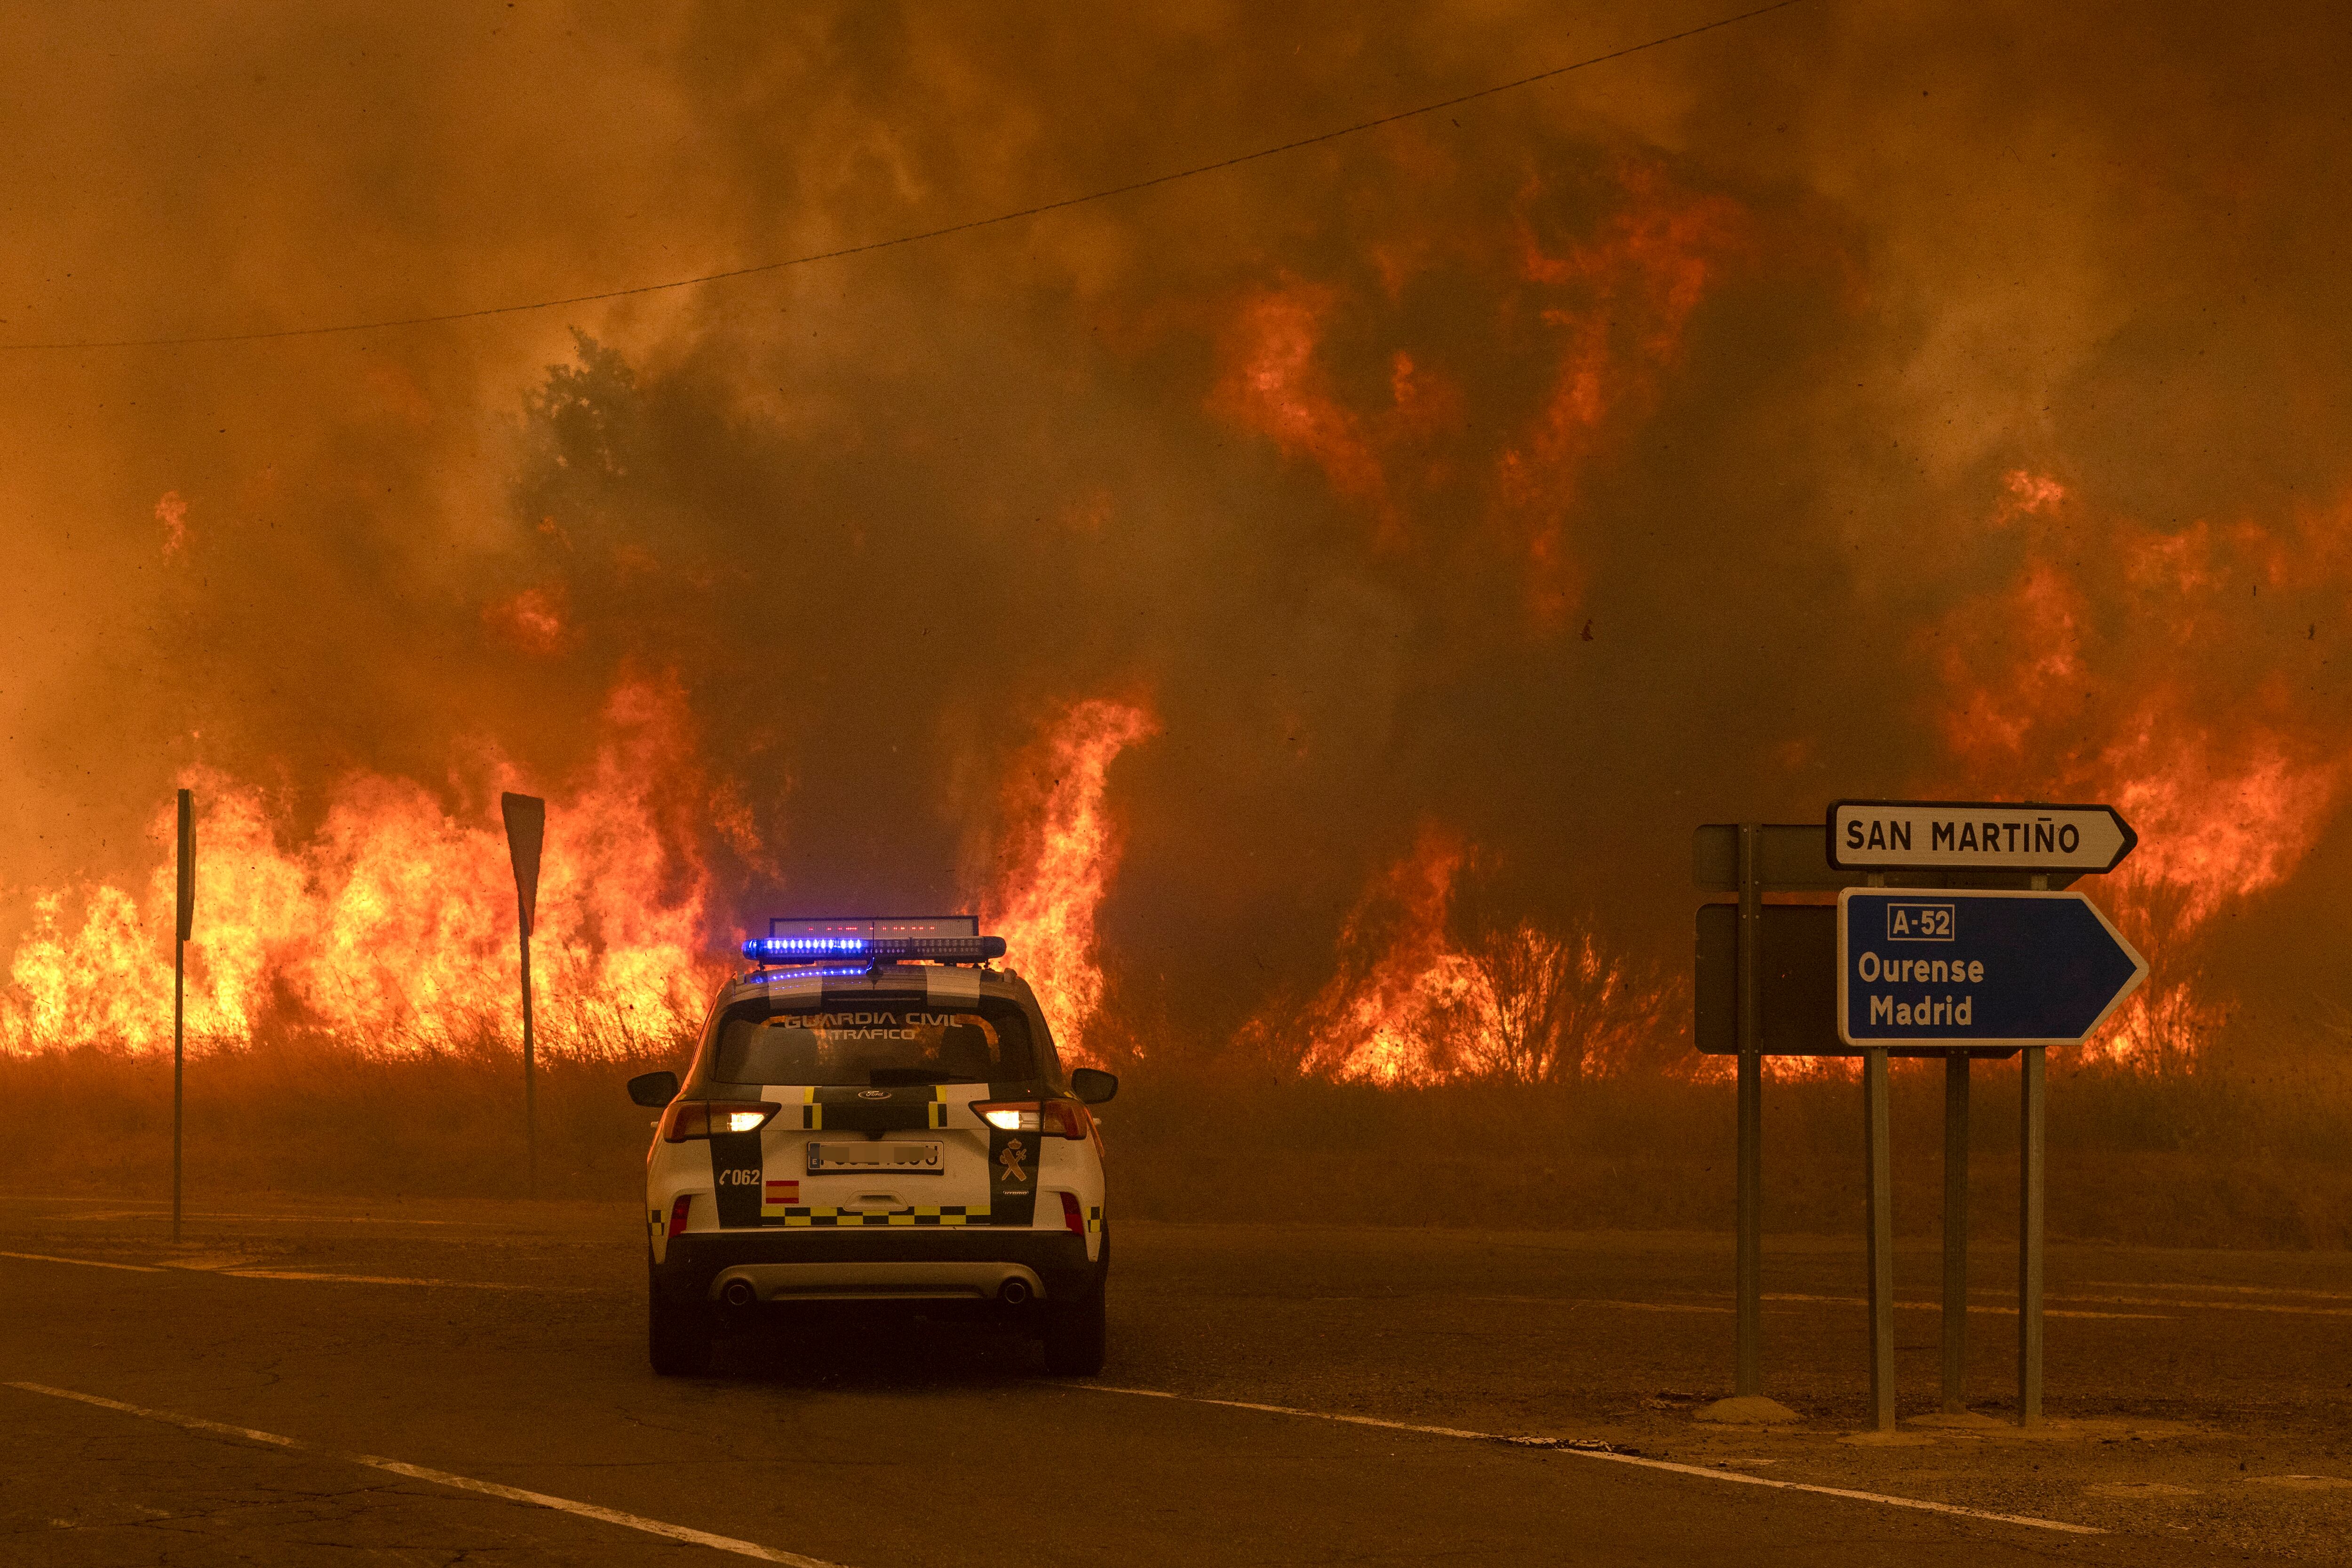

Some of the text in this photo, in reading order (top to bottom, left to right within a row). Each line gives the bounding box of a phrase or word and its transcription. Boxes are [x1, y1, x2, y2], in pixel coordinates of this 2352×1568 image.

[1846, 817, 2080, 853] SAN MARTIÑO
[1892, 910, 1950, 934] A-52
[1859, 951, 1984, 983] Ourense
[784, 1012, 963, 1029] GUARDIA CIVIL
[1870, 995, 1971, 1025] Madrid
[831, 1026, 916, 1041] TRÁFICO
[732, 1169, 760, 1185] 062
